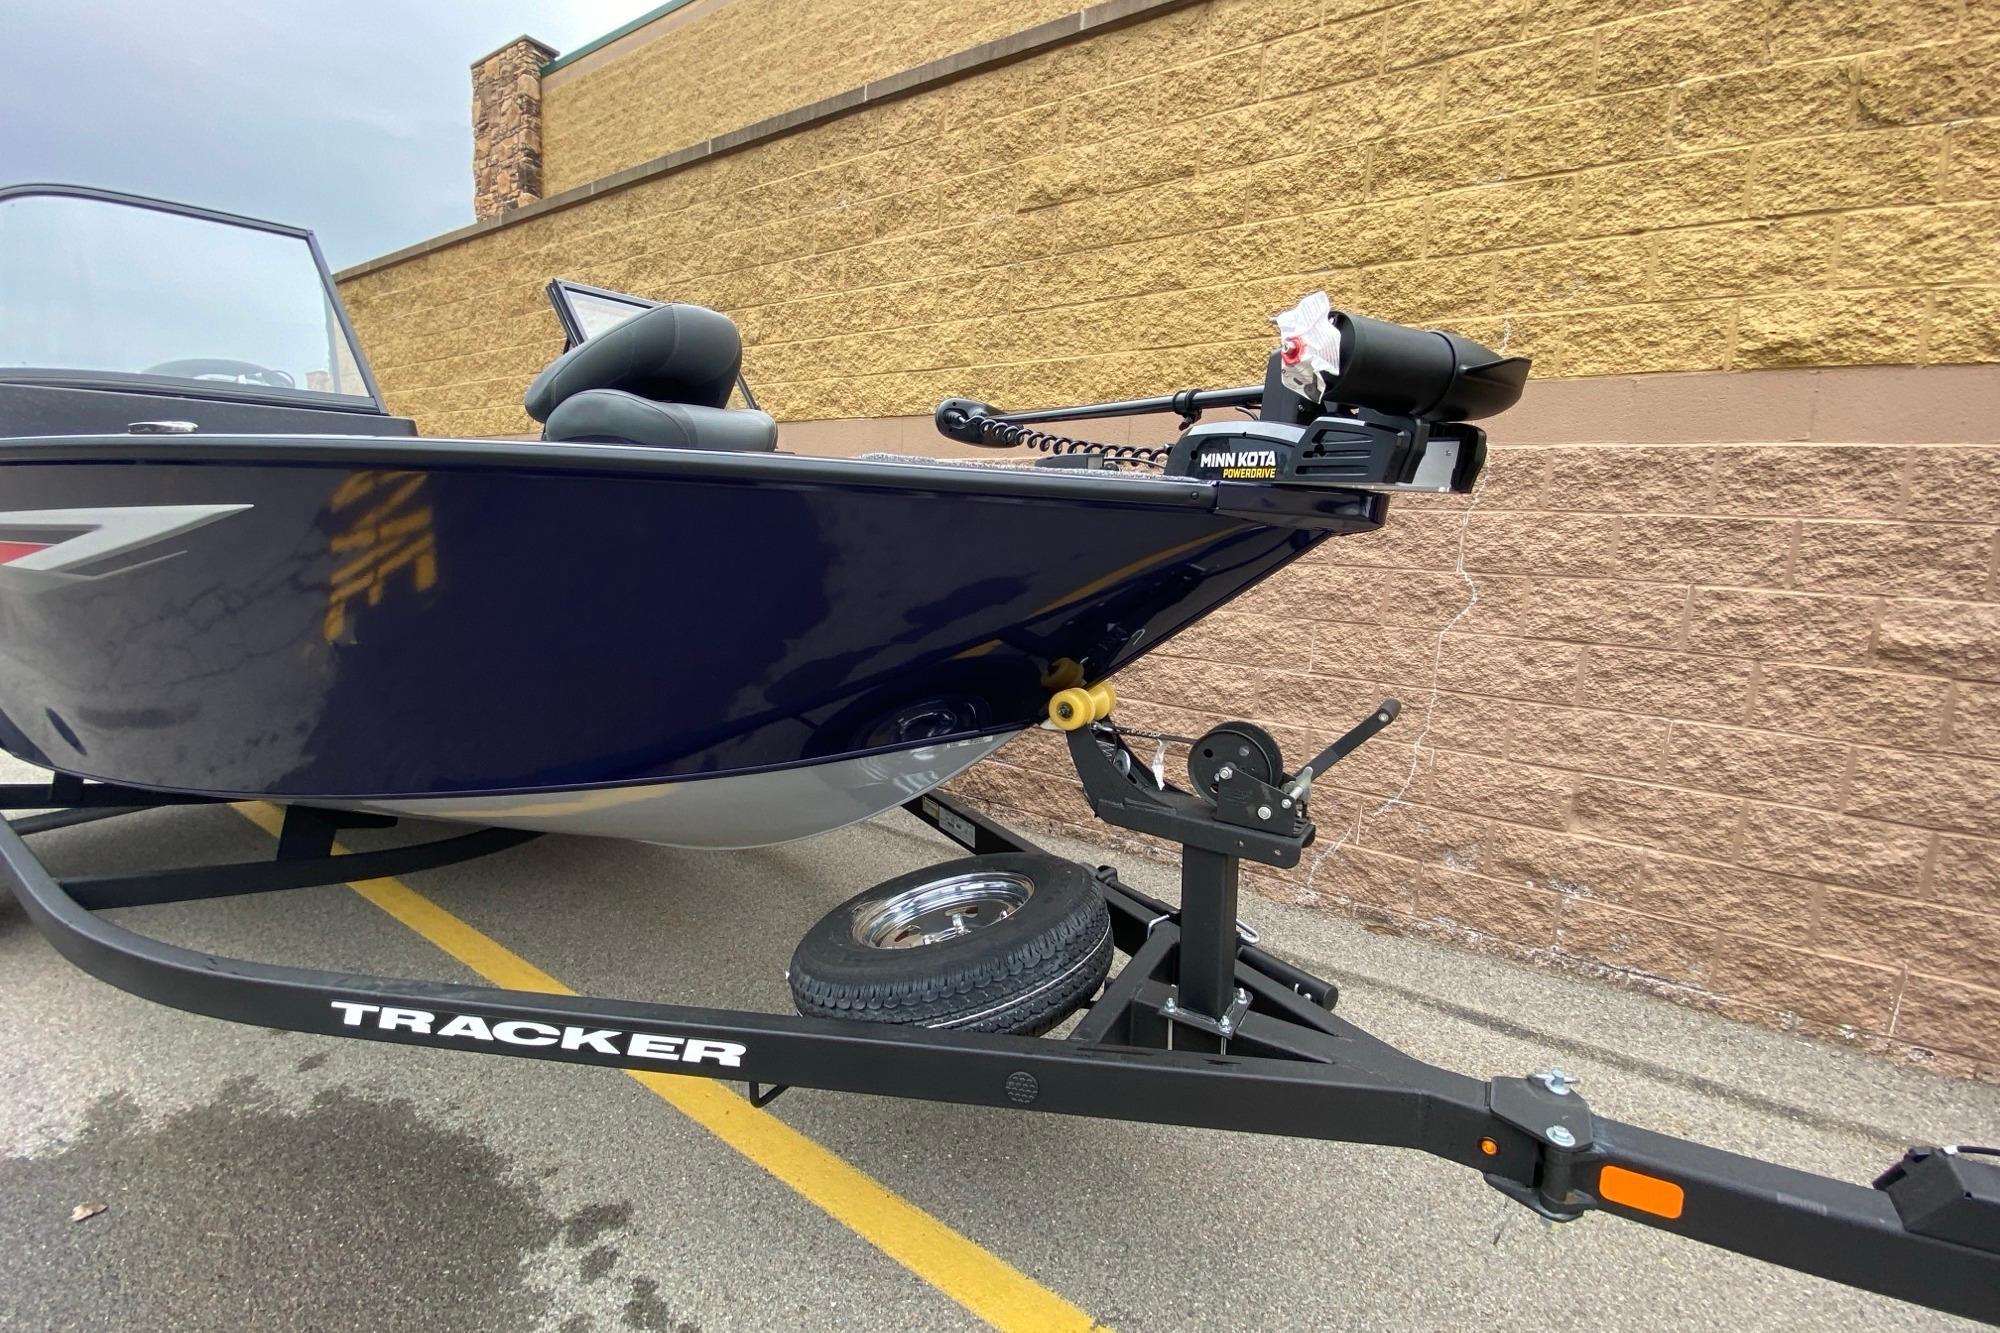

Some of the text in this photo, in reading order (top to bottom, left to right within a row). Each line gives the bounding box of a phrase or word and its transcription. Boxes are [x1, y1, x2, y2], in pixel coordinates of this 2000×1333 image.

[1200, 450, 1276, 468] MINN KOTA
[1222, 467, 1276, 479] POWERDRIVE
[330, 1001, 748, 1068] TRACKER
